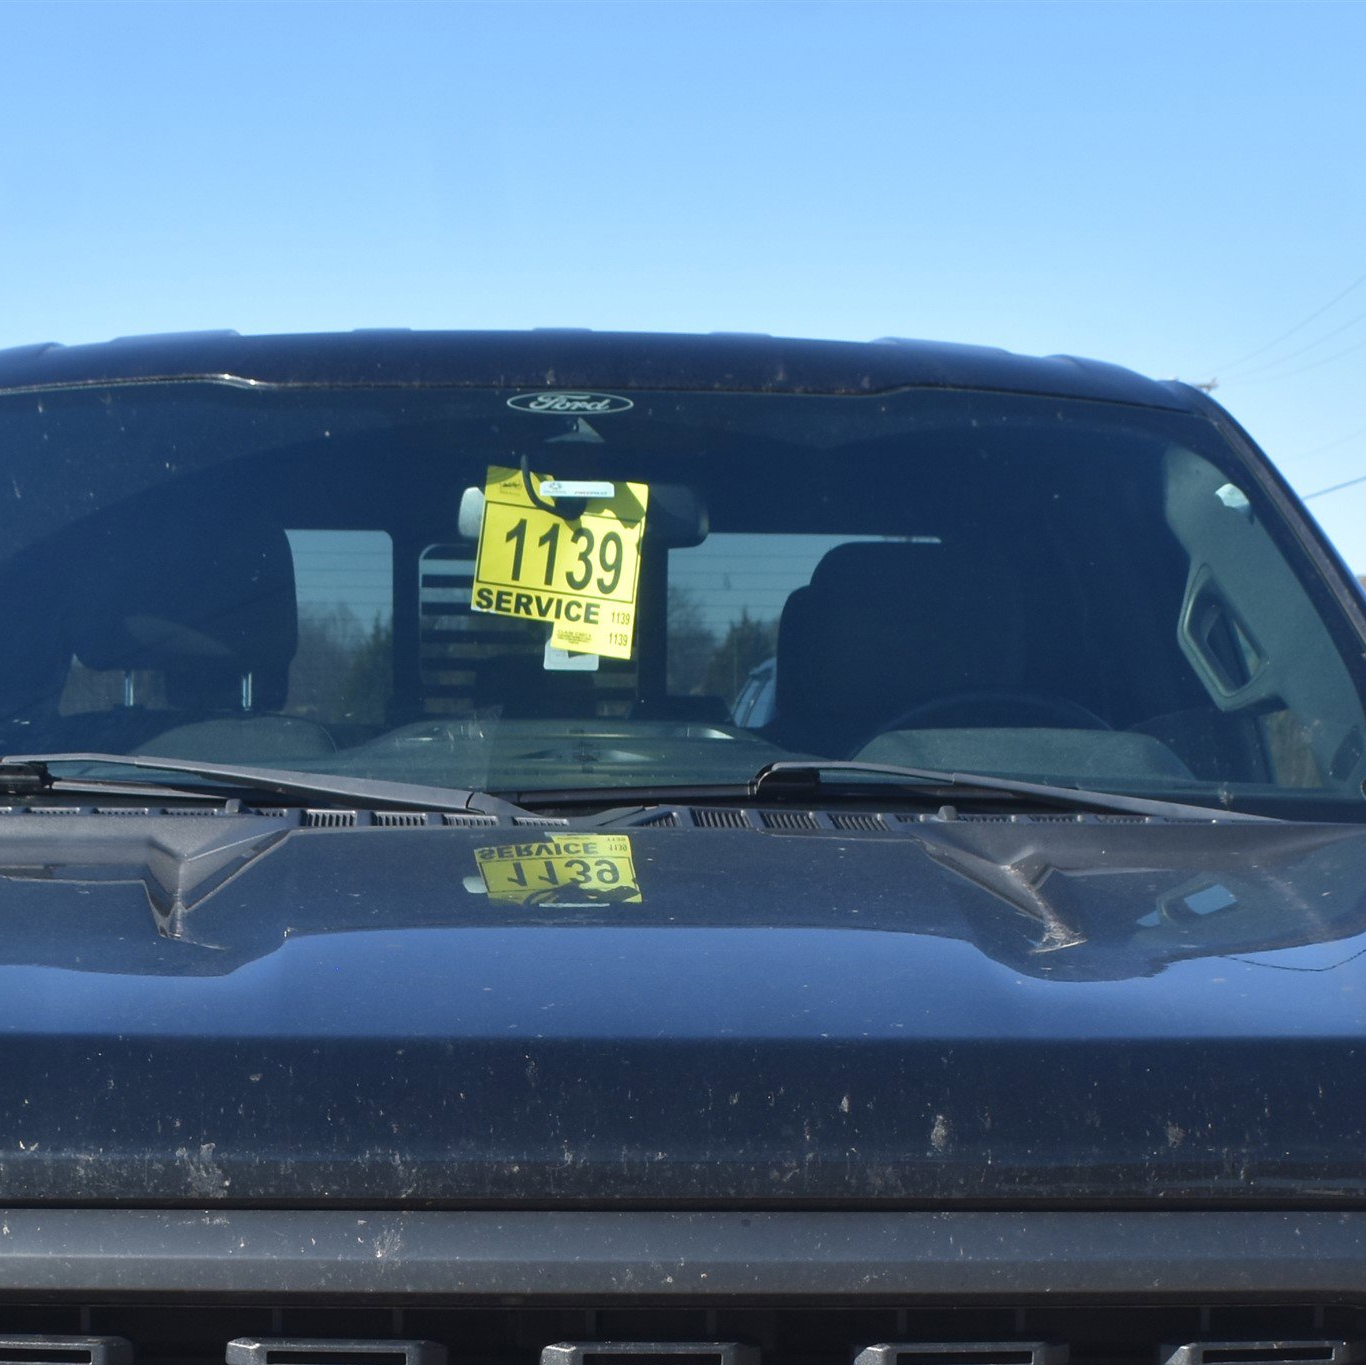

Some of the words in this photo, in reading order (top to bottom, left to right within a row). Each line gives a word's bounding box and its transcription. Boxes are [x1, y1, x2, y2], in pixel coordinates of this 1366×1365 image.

[529, 395, 612, 411] Ford
[505, 518, 624, 595] 1139
[475, 587, 602, 625] SERVICE
[611, 611, 631, 626] 1139
[609, 632, 629, 647] 1139
